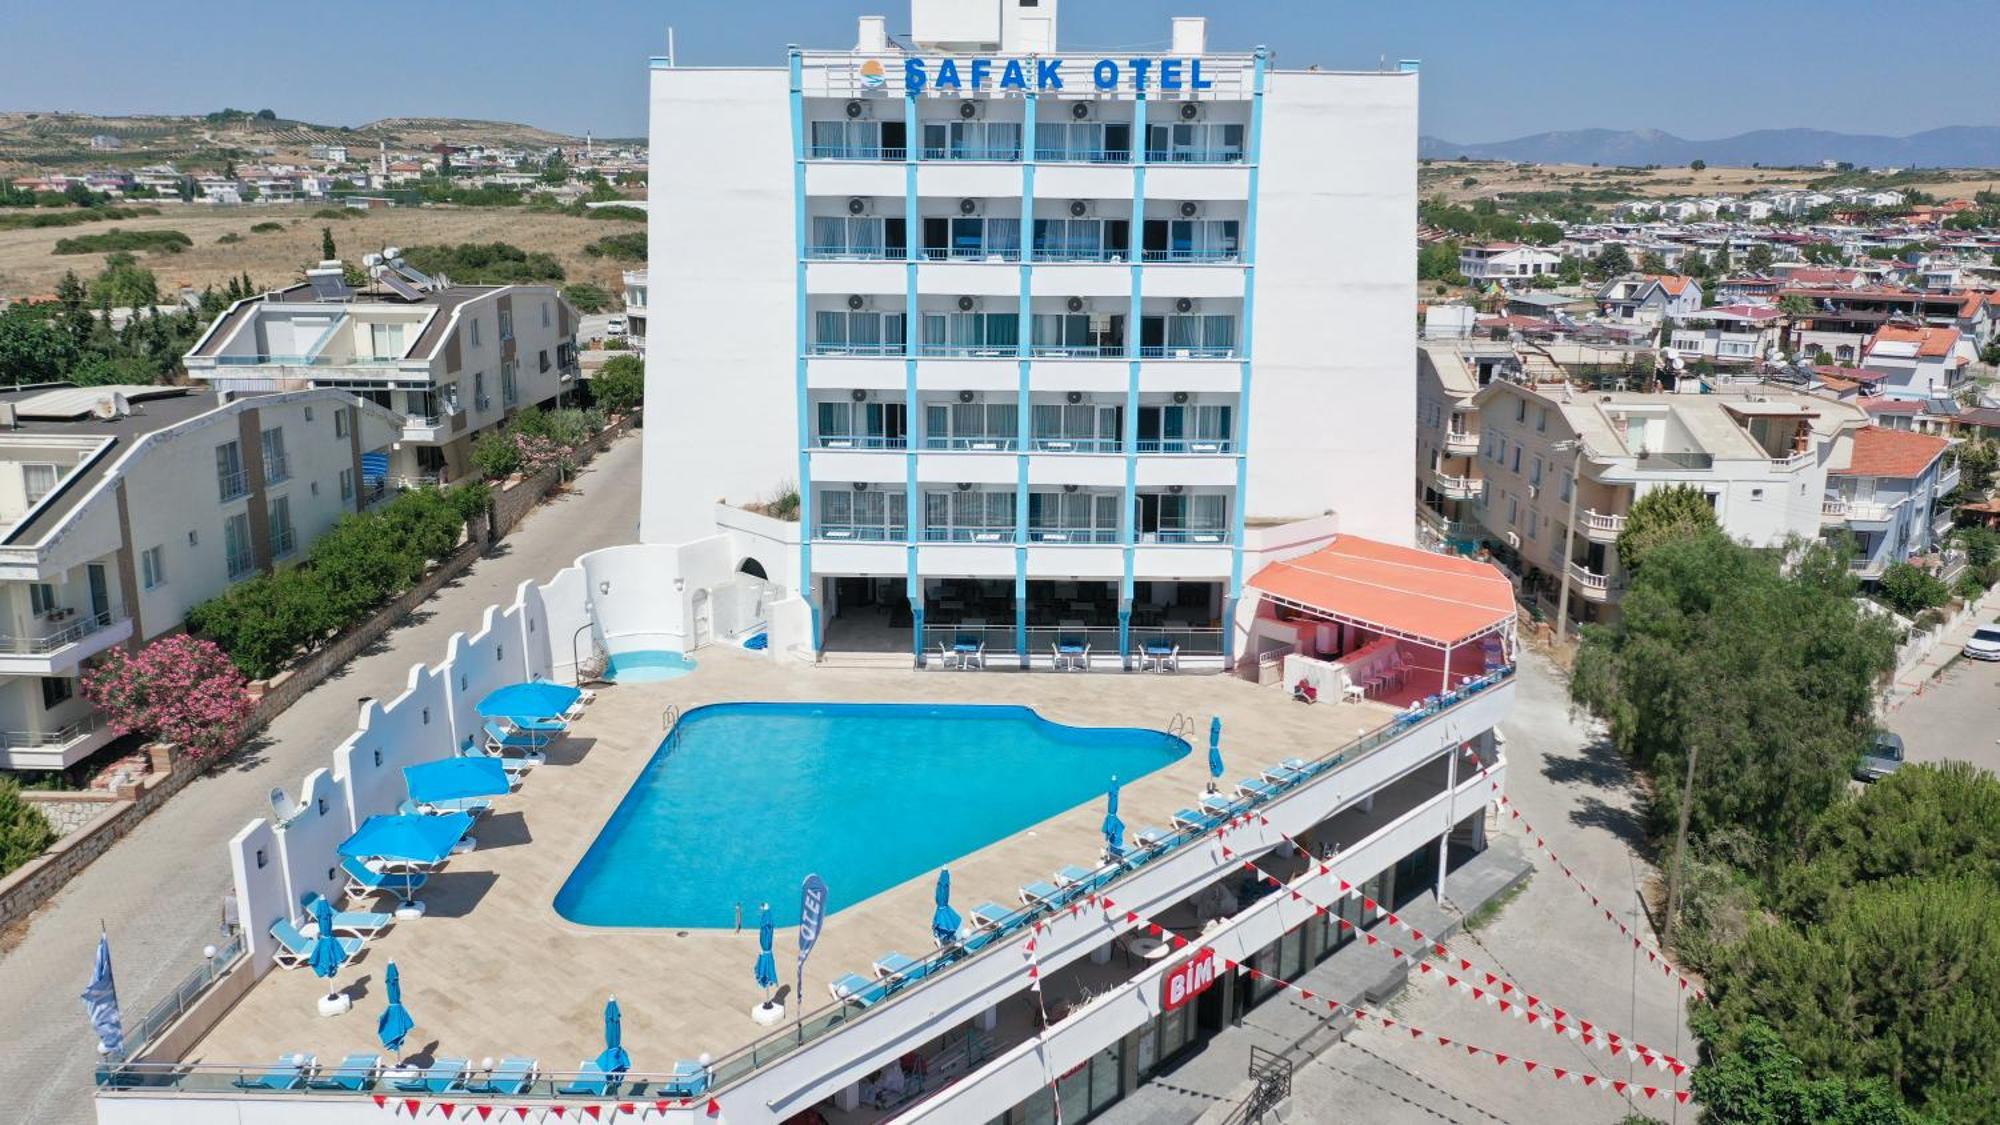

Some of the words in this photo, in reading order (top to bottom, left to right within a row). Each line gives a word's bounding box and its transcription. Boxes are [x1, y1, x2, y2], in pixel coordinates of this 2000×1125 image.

[904, 58, 1064, 97] ŞAFAK
[1093, 58, 1212, 90] OTEL
[801, 888, 821, 941] OTEL
[1170, 957, 1212, 1005] BİM
